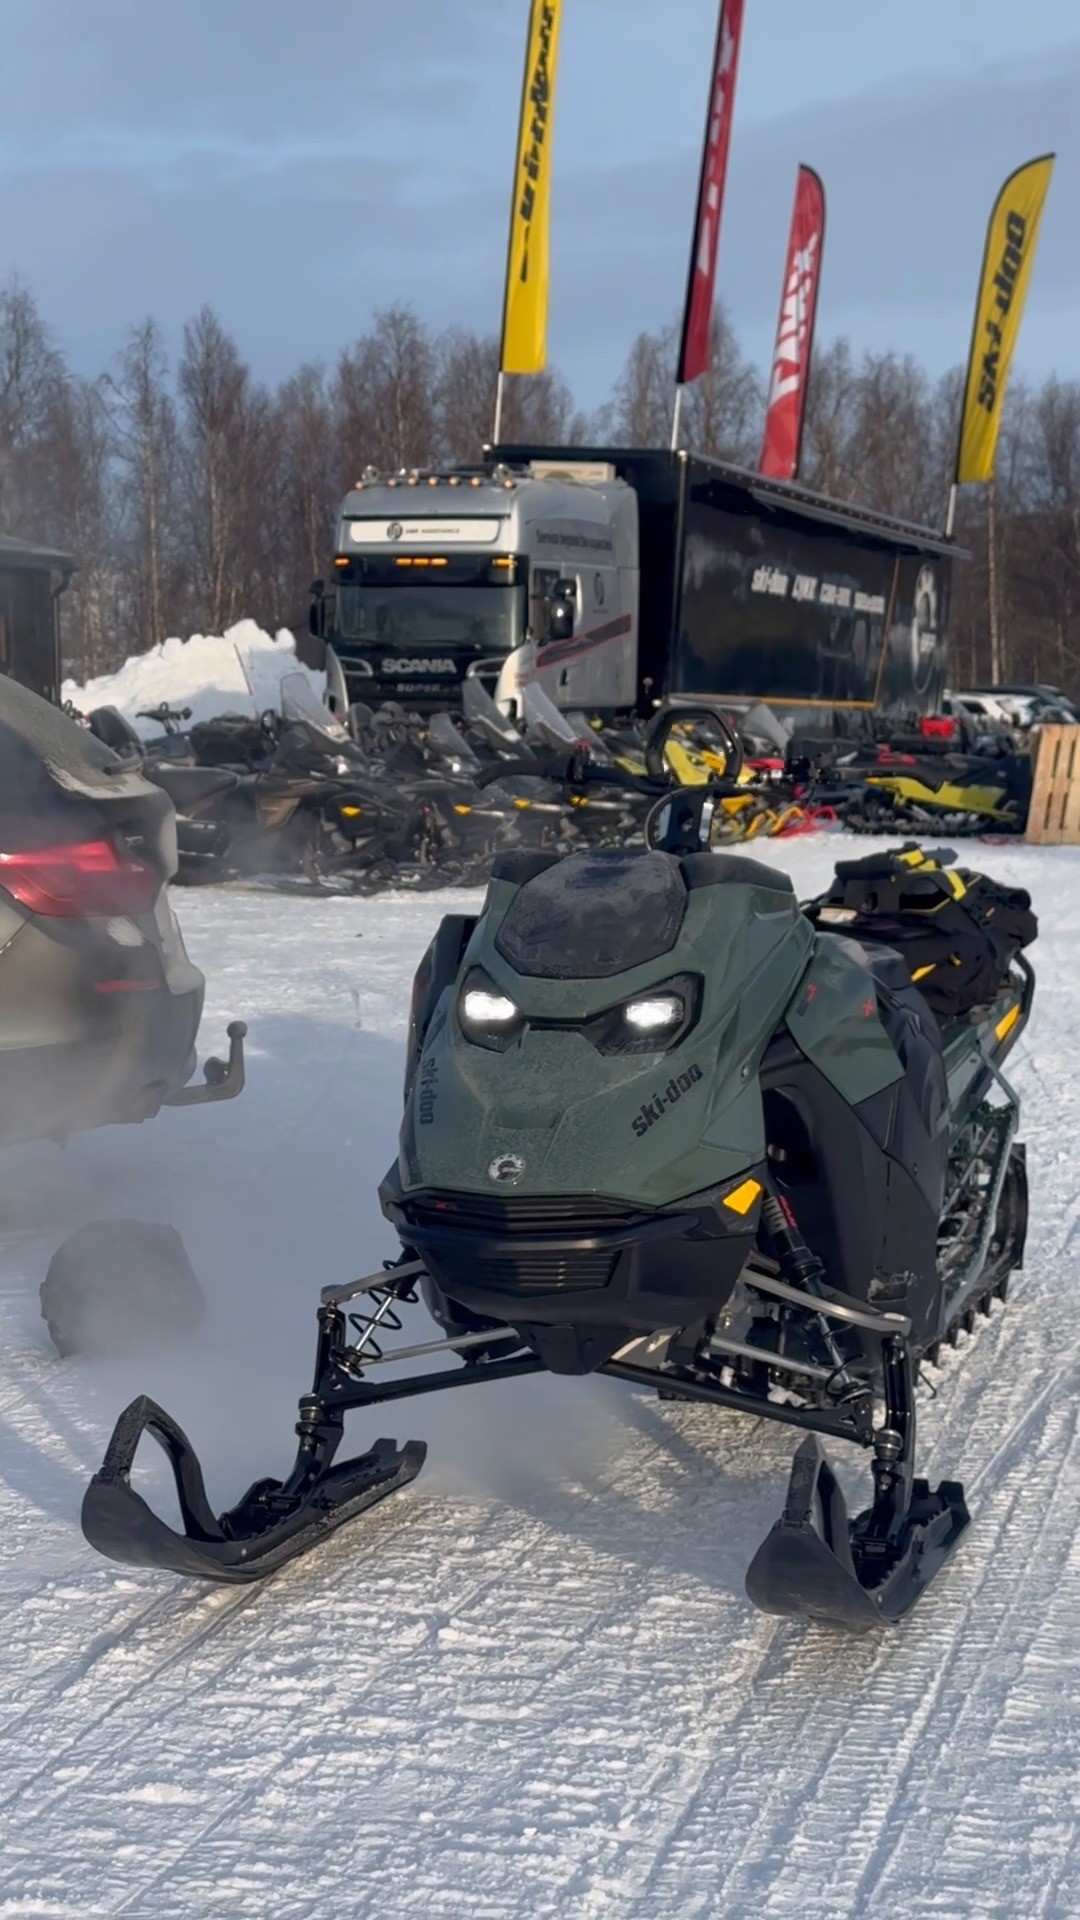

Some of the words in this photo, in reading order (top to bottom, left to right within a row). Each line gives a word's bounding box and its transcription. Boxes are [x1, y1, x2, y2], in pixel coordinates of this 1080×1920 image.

[381, 658, 457, 674] SCANIA
[419, 1057, 439, 1126] ski-doo
[631, 1064, 703, 1137] ski-doo
